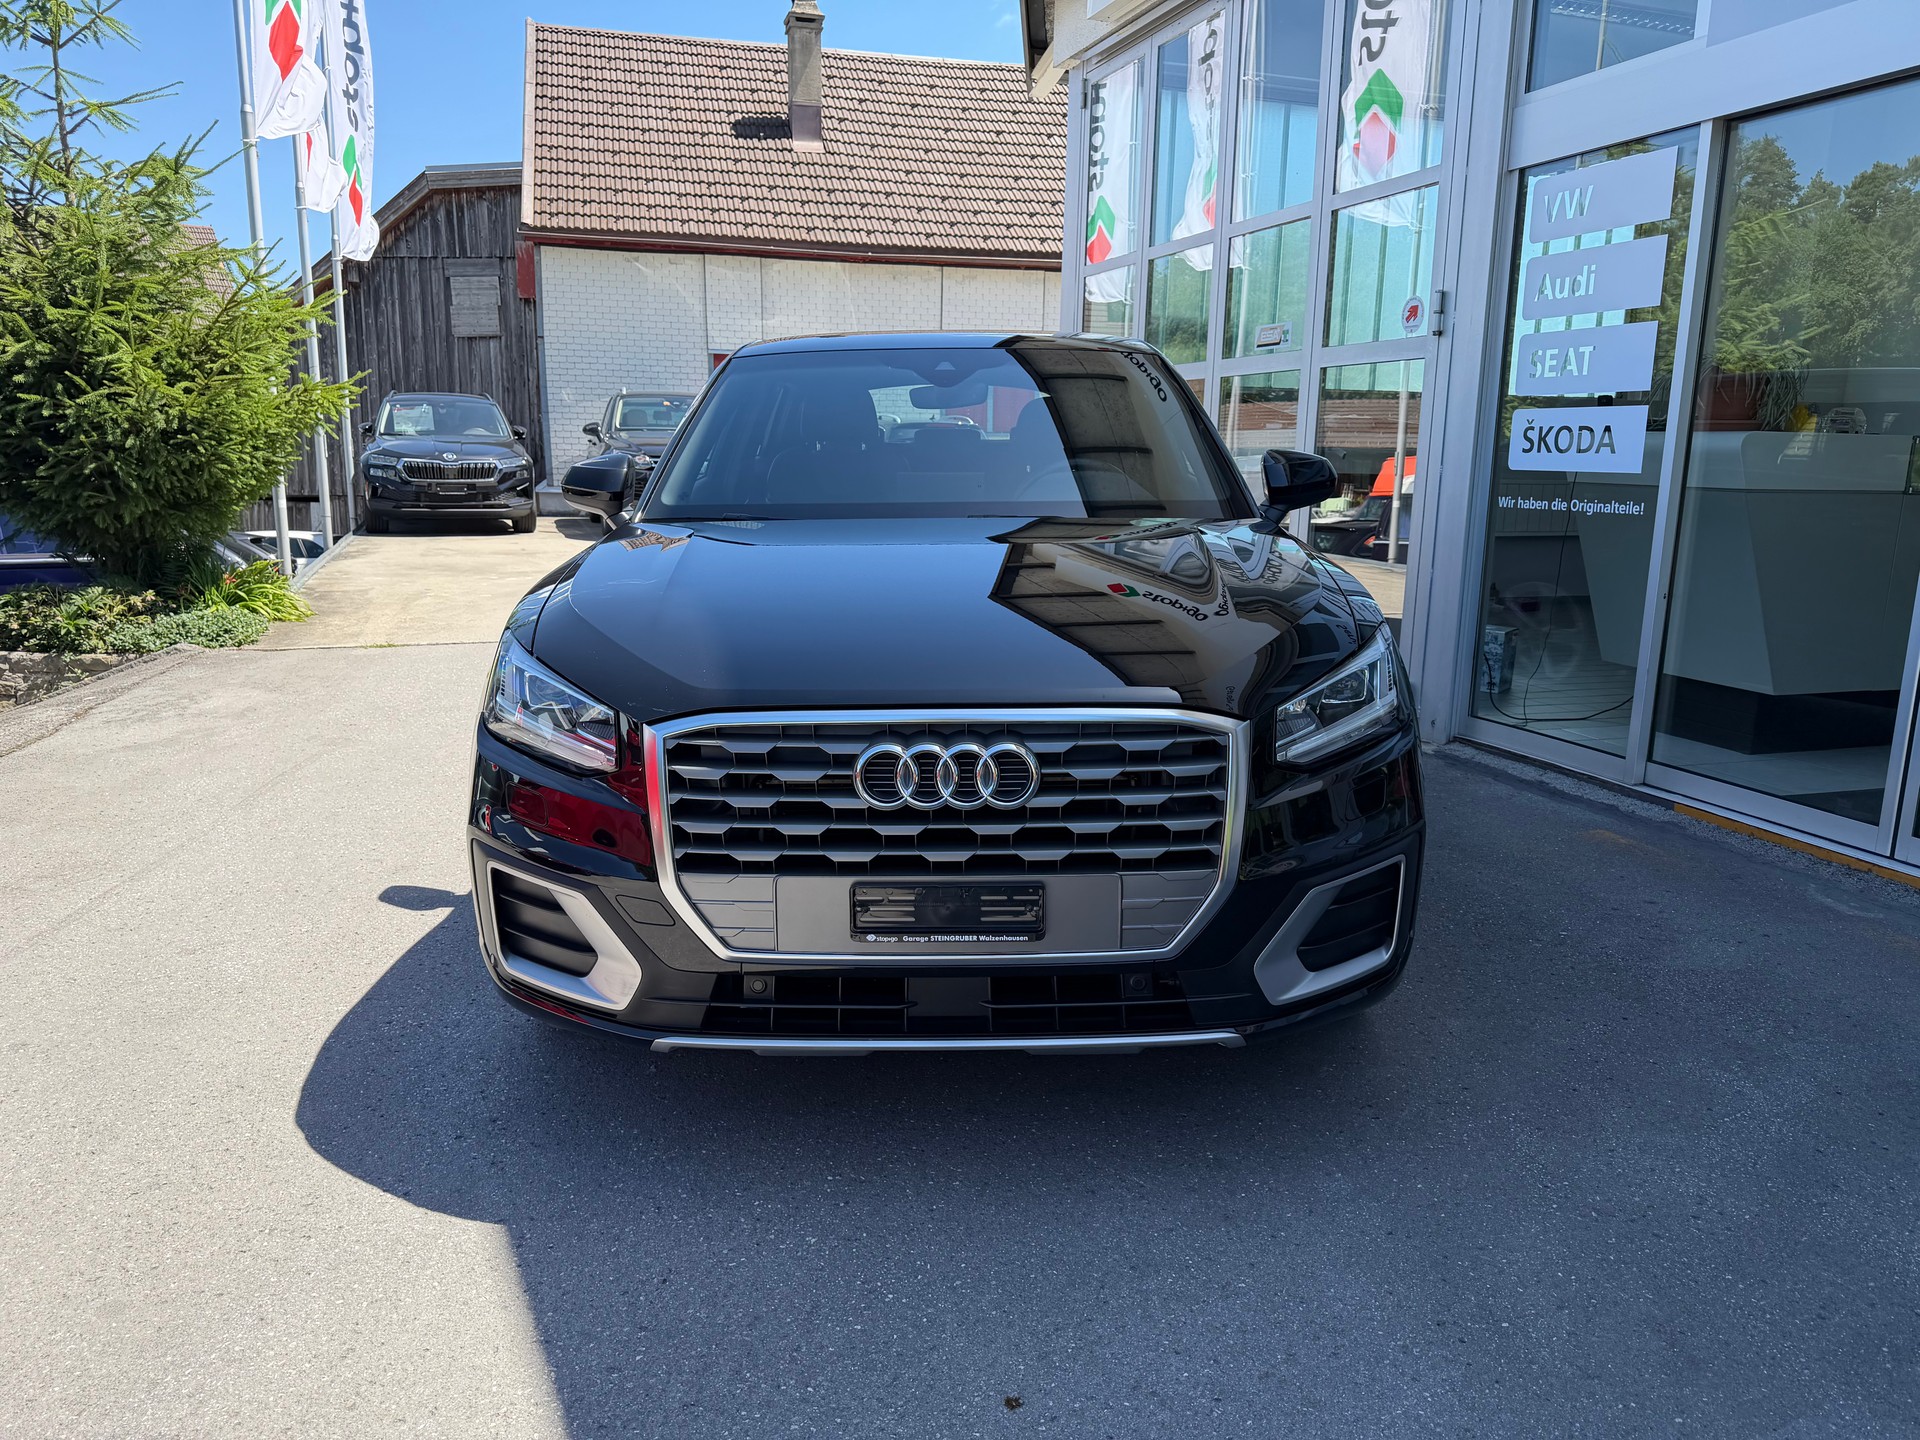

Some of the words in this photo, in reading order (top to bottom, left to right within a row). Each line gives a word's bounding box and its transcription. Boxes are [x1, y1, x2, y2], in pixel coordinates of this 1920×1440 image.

[1544, 184, 1594, 223] VW
[1534, 263, 1597, 302] Audi
[1529, 345, 1597, 379] SEAT
[1522, 418, 1616, 454] ŠKODA
[1498, 496, 1516, 508] Wir
[1517, 496, 1549, 510] haben
[1551, 498, 1567, 511] die
[1570, 499, 1645, 515] Originalteile!
[902, 935, 930, 943] Garage
[978, 934, 1029, 942] Walzenhausen
